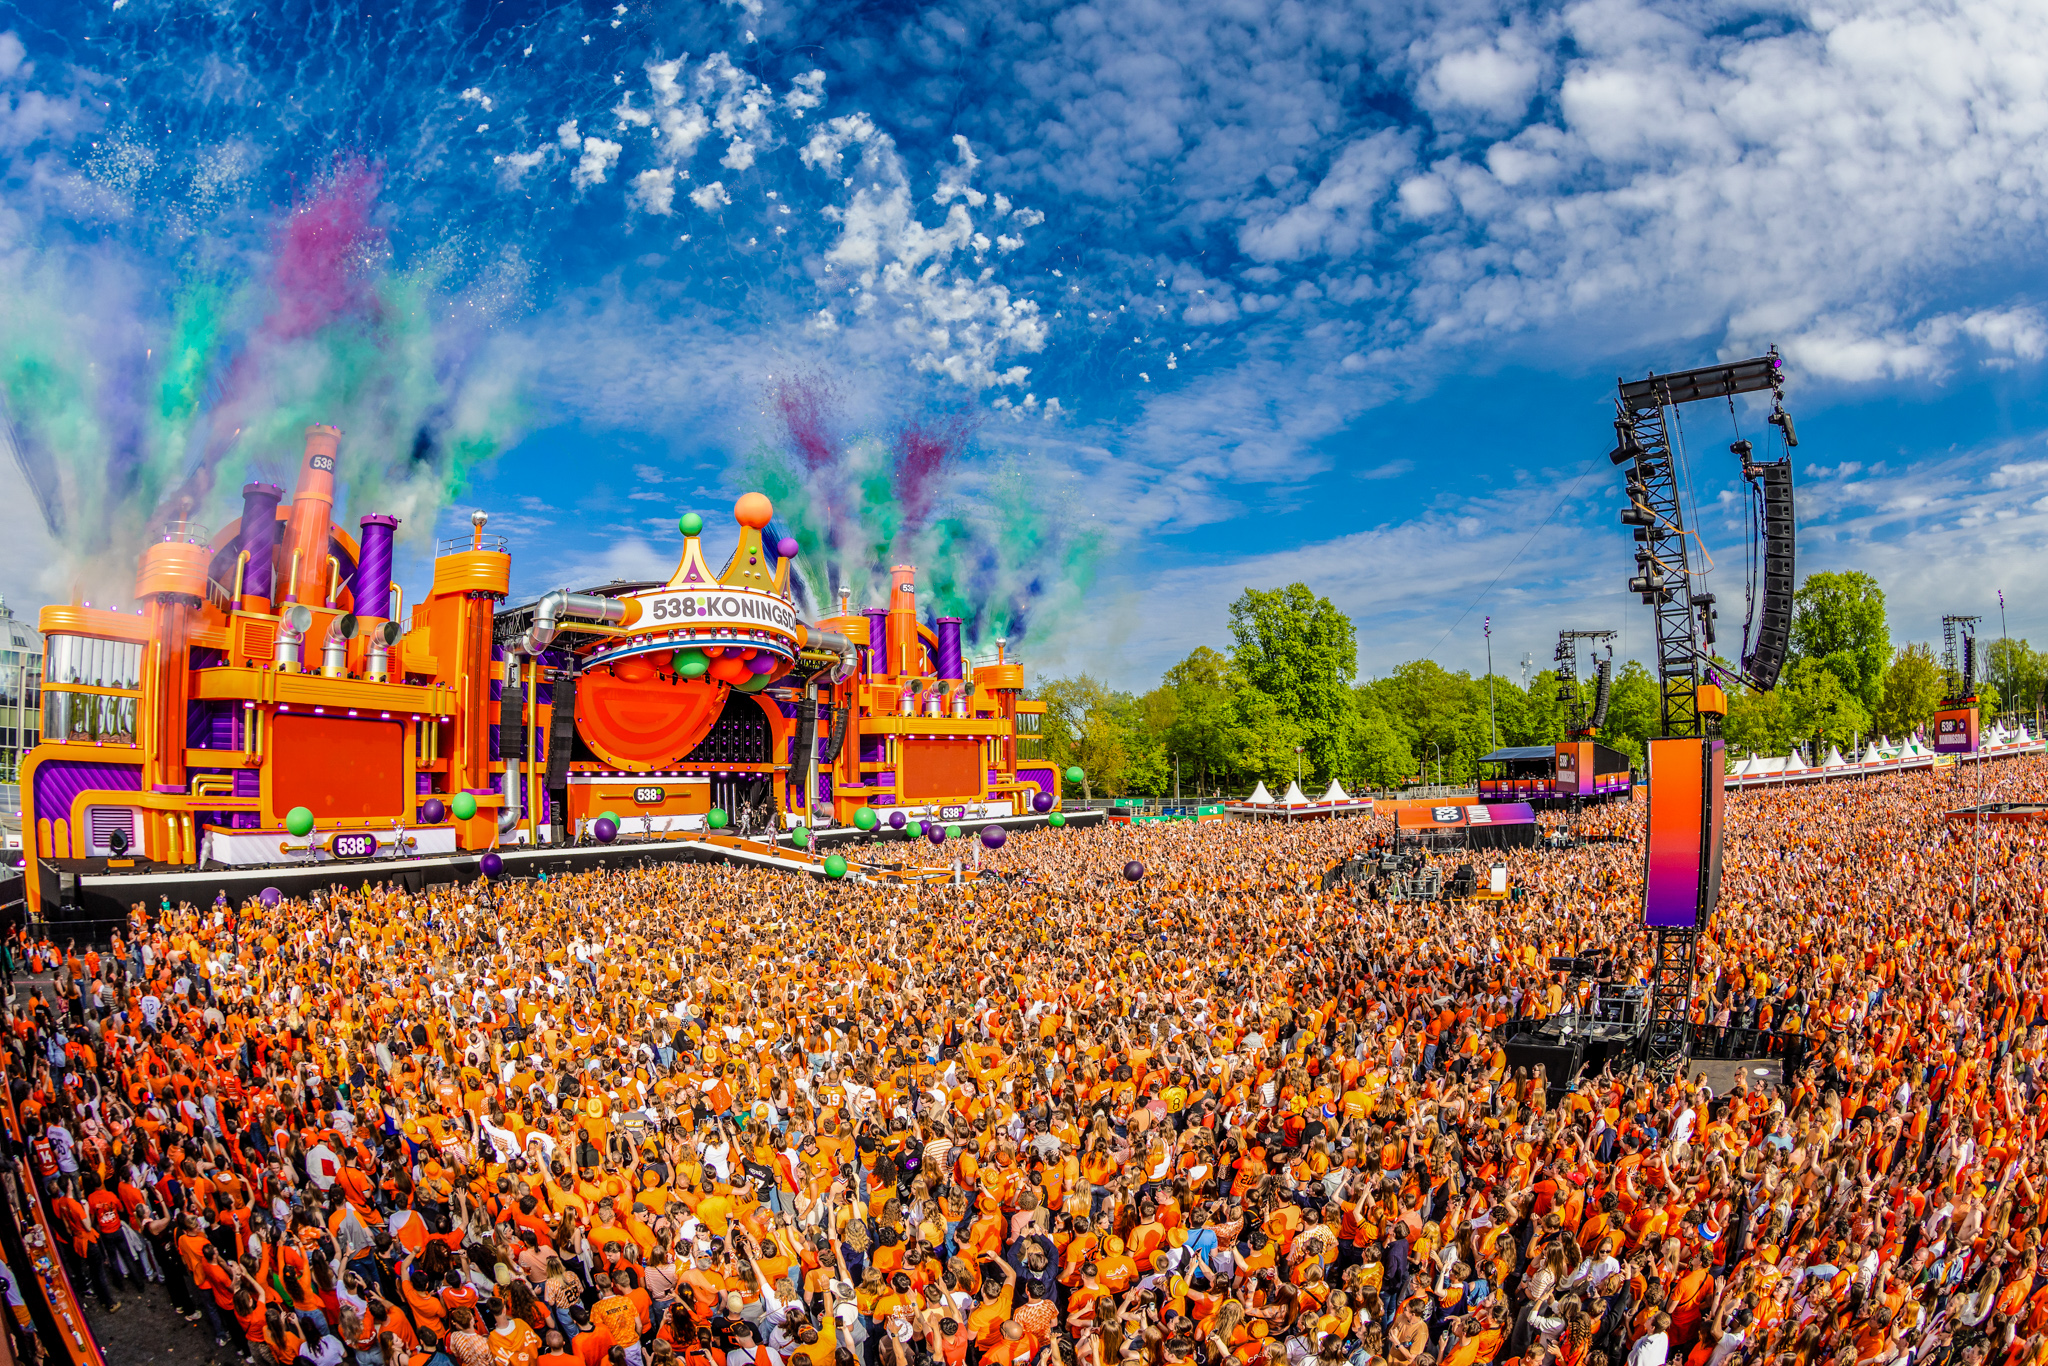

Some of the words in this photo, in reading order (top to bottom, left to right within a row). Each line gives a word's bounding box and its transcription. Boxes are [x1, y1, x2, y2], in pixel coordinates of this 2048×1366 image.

[314, 457, 332, 470] 538
[653, 597, 696, 620] 538
[637, 788, 657, 801] 538
[943, 807, 959, 818] 538
[338, 837, 366, 855] 538
[827, 1094, 841, 1106] 19
[1173, 1097, 1180, 1110] 8
[40, 1150, 53, 1163] 14
